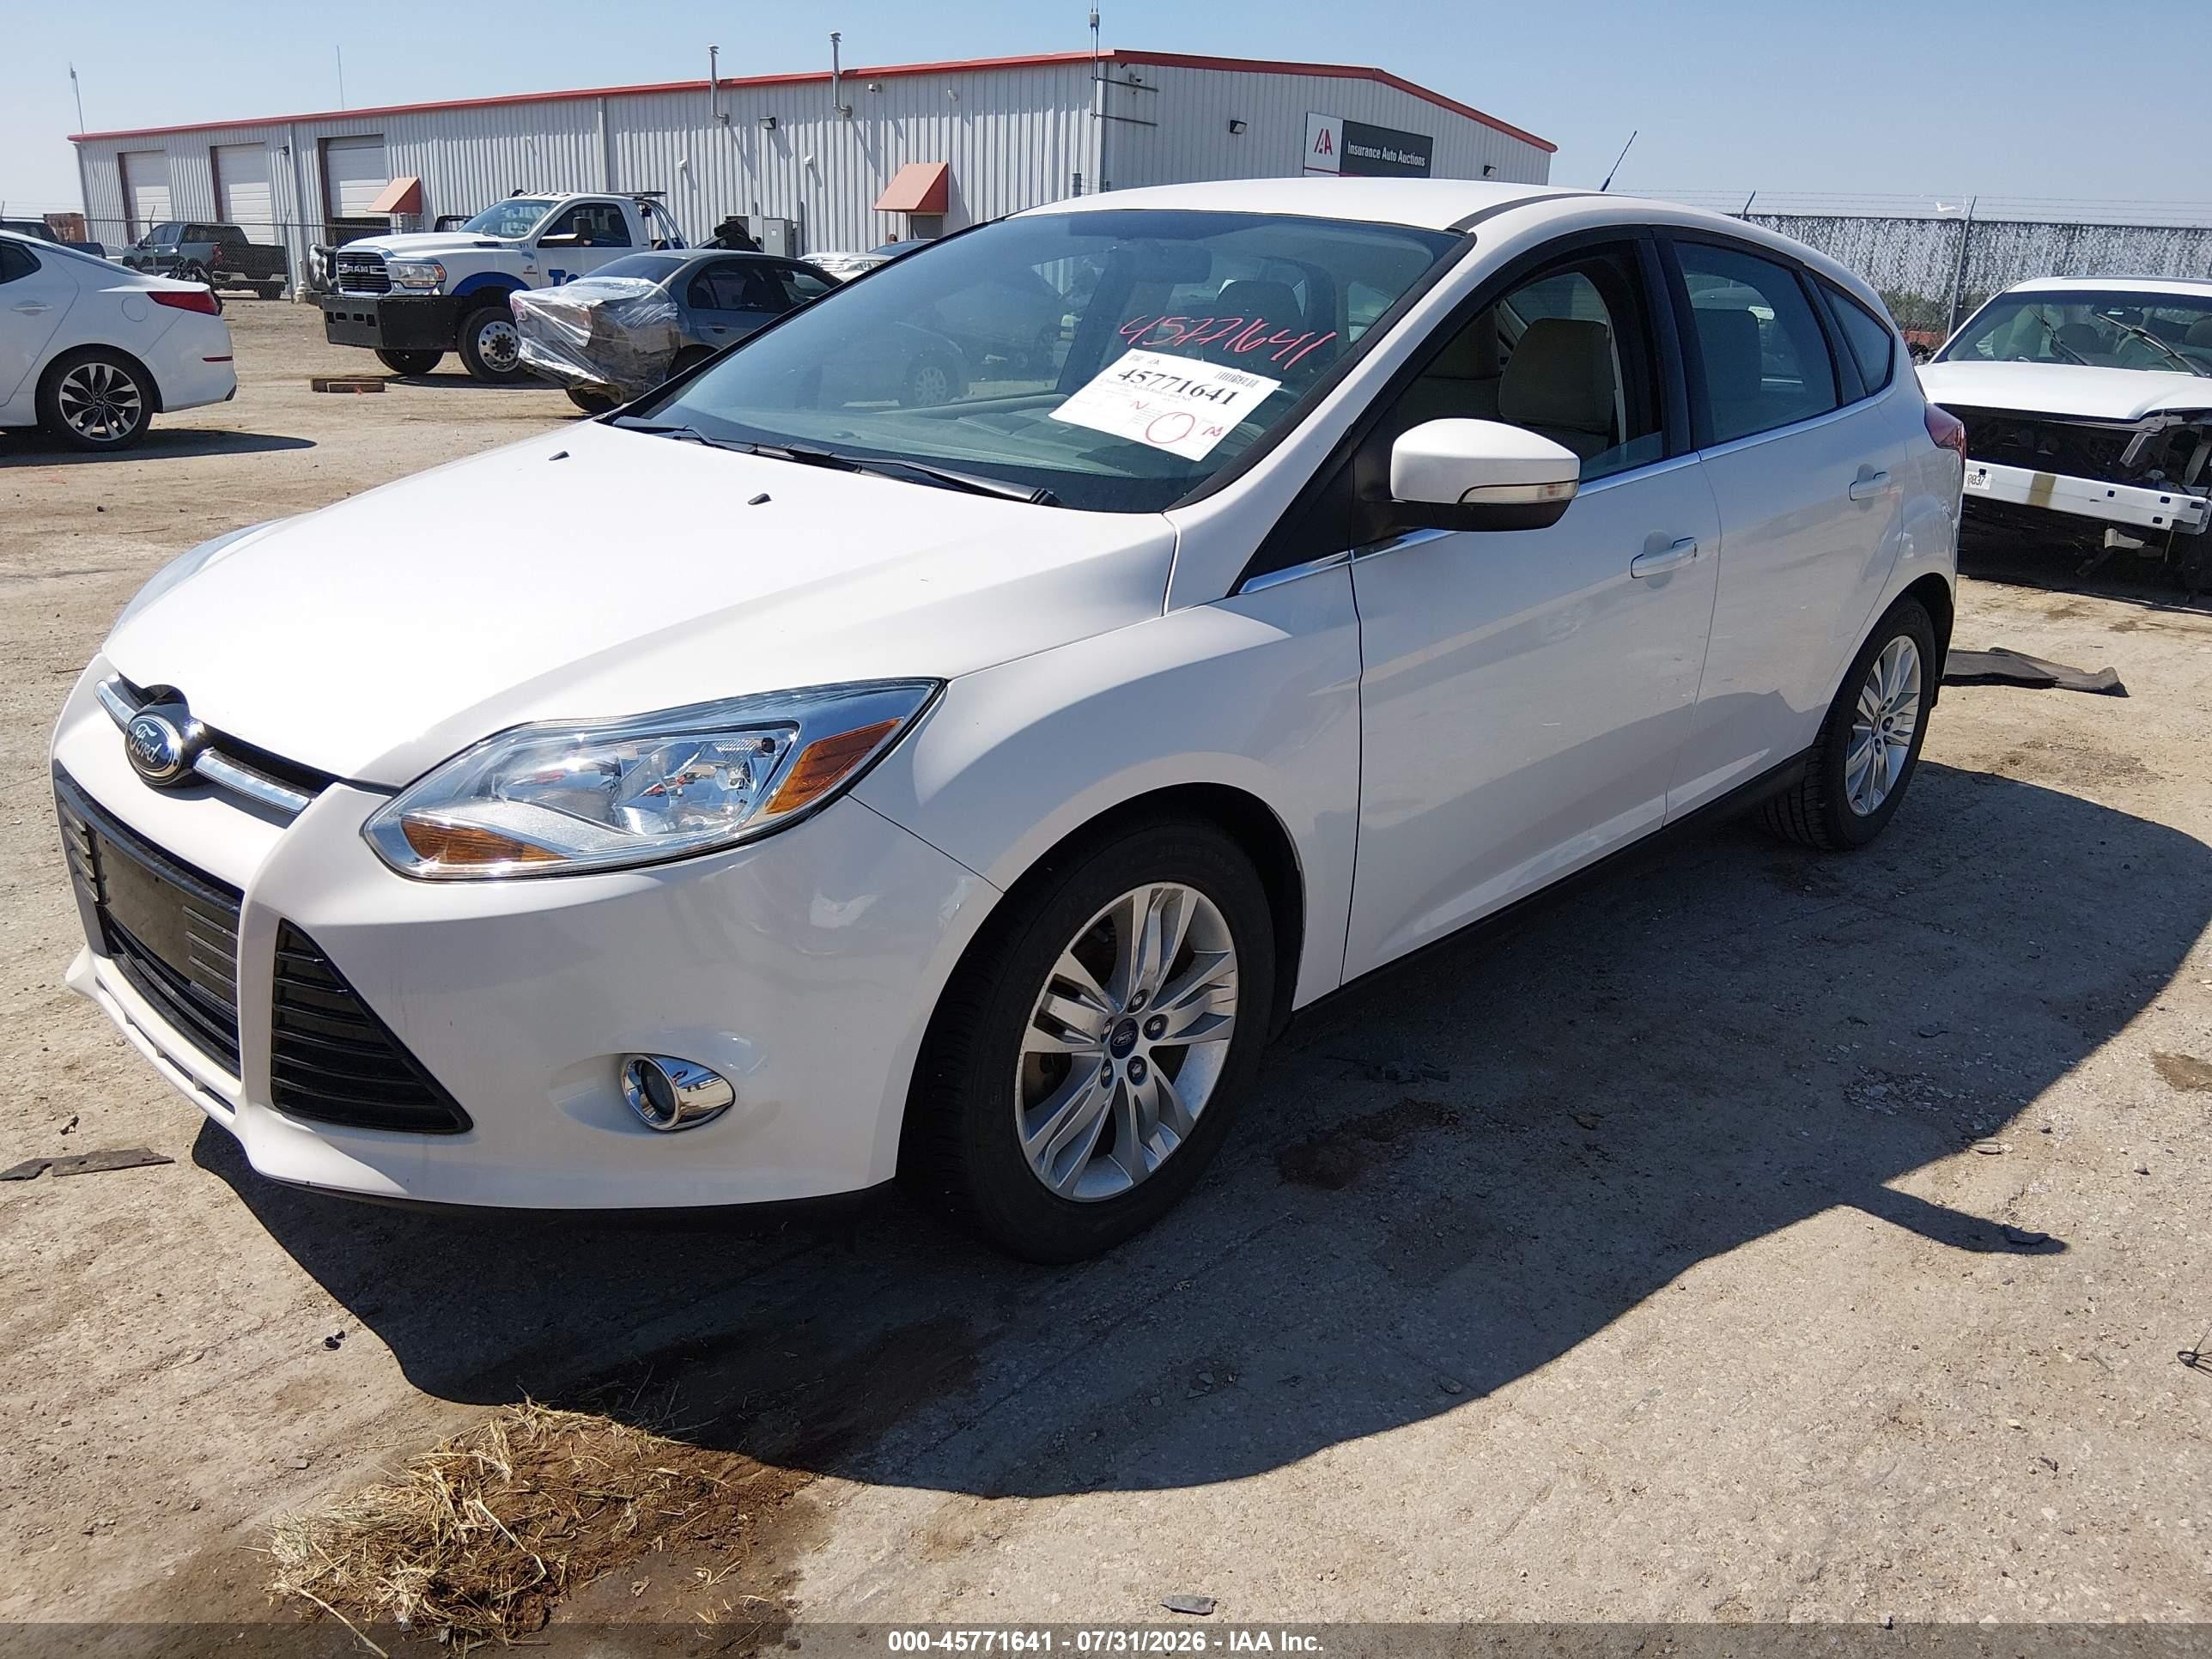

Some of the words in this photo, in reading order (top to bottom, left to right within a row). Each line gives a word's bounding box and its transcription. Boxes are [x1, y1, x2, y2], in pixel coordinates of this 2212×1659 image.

[1347, 140, 1381, 160] Insurance
[1382, 147, 1398, 162] Auto
[1398, 149, 1426, 167] Auctions
[1119, 314, 1337, 370] 45771641
[1117, 368, 1240, 405] 45771641
[129, 723, 161, 763] Ford
